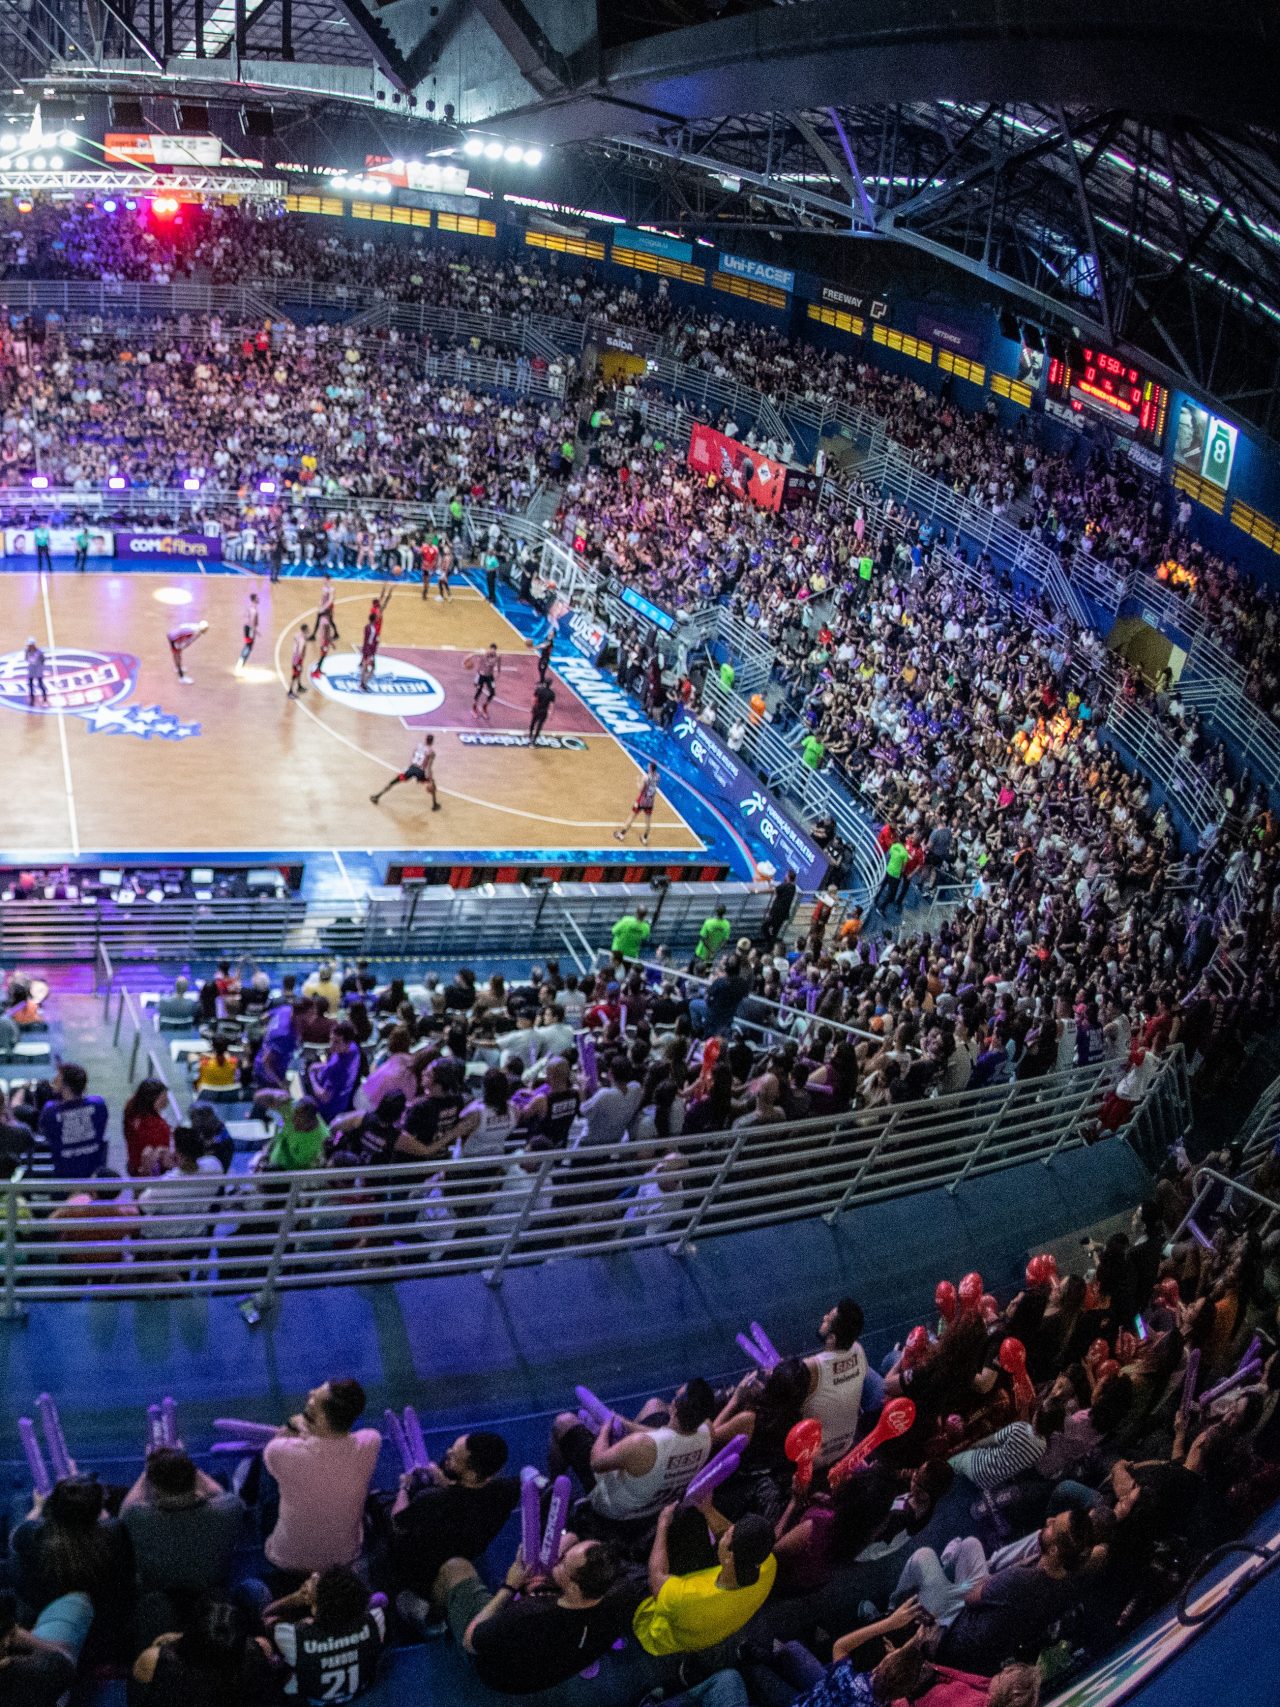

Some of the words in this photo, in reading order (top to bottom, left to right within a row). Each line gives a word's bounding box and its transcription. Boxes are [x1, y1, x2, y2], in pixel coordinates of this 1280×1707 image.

[822, 287, 863, 309] FREEWAY
[1044, 399, 1085, 429] FEAC
[1214, 438, 1228, 463] 8
[549, 655, 652, 735] FRANCA
[303, 1623, 371, 1654] Unimed
[320, 1663, 359, 1701] 21
